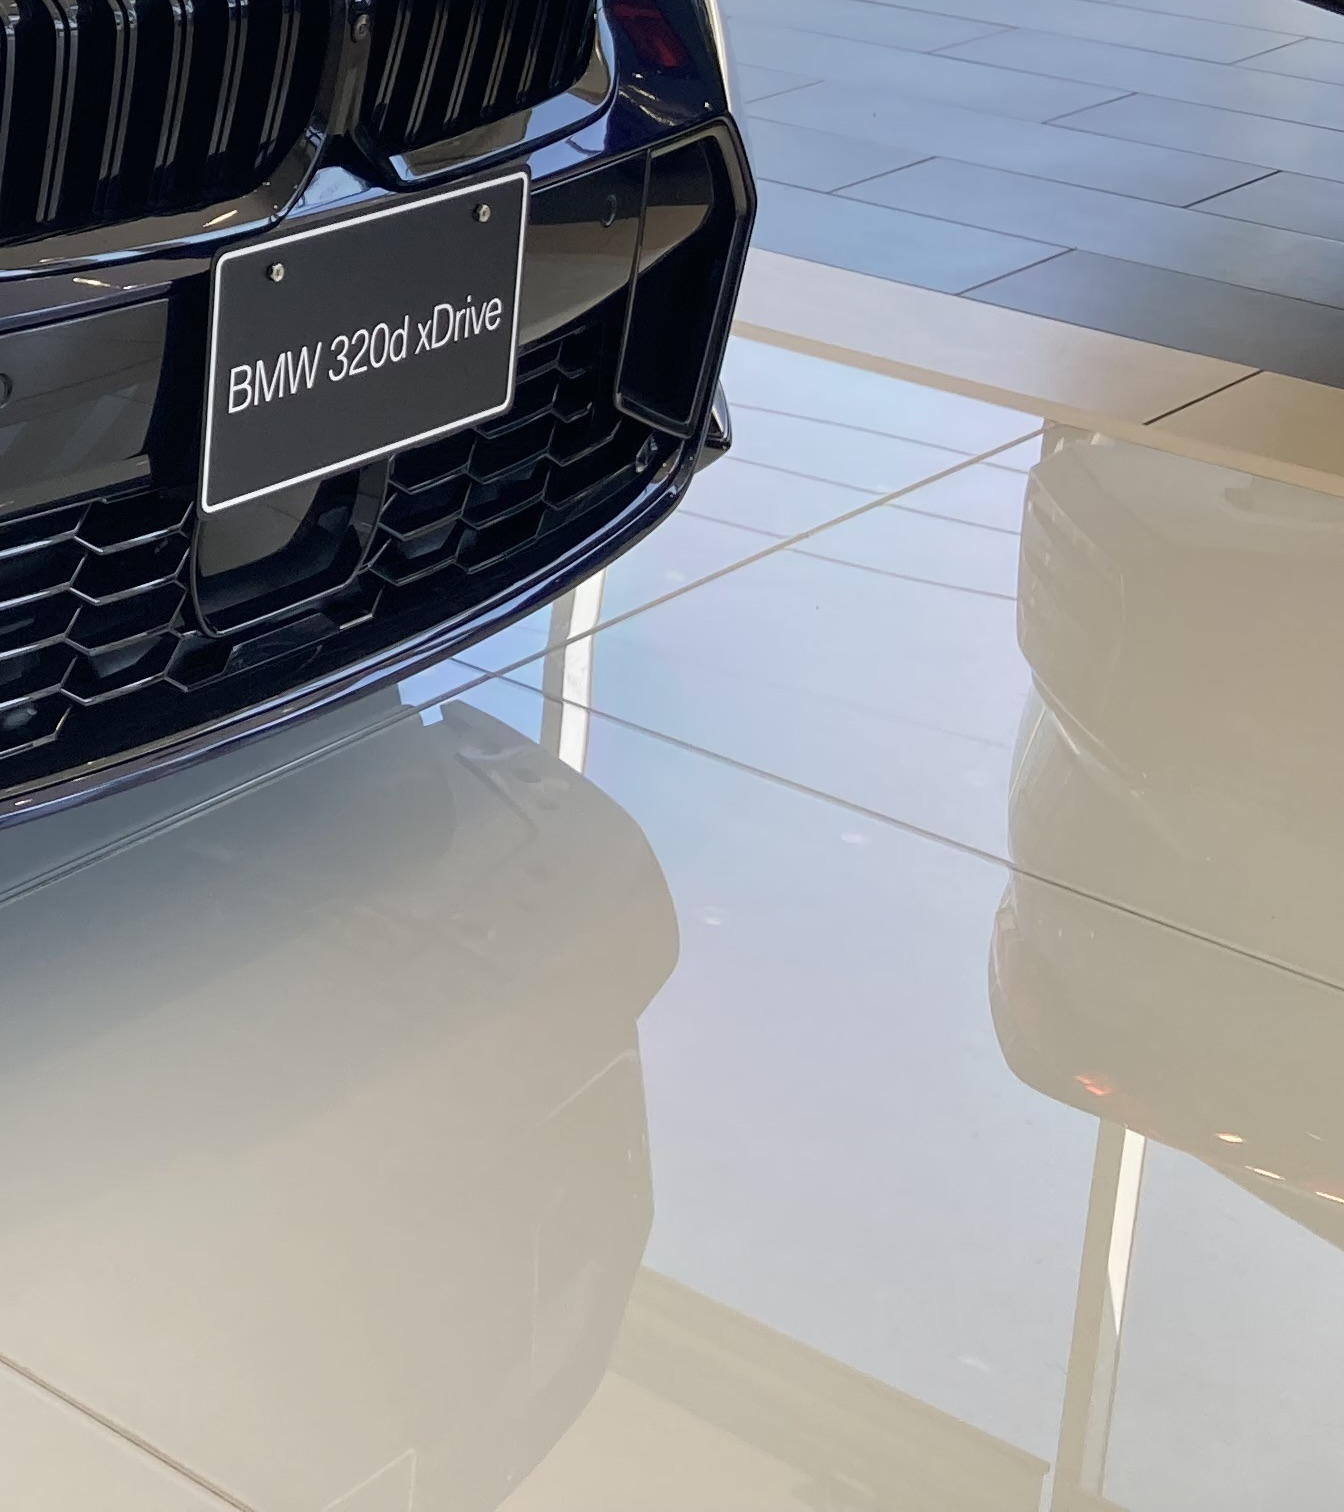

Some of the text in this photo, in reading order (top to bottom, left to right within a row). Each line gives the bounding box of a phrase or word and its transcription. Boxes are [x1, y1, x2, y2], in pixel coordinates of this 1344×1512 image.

[228, 294, 503, 414] BMW 320d xDrive
